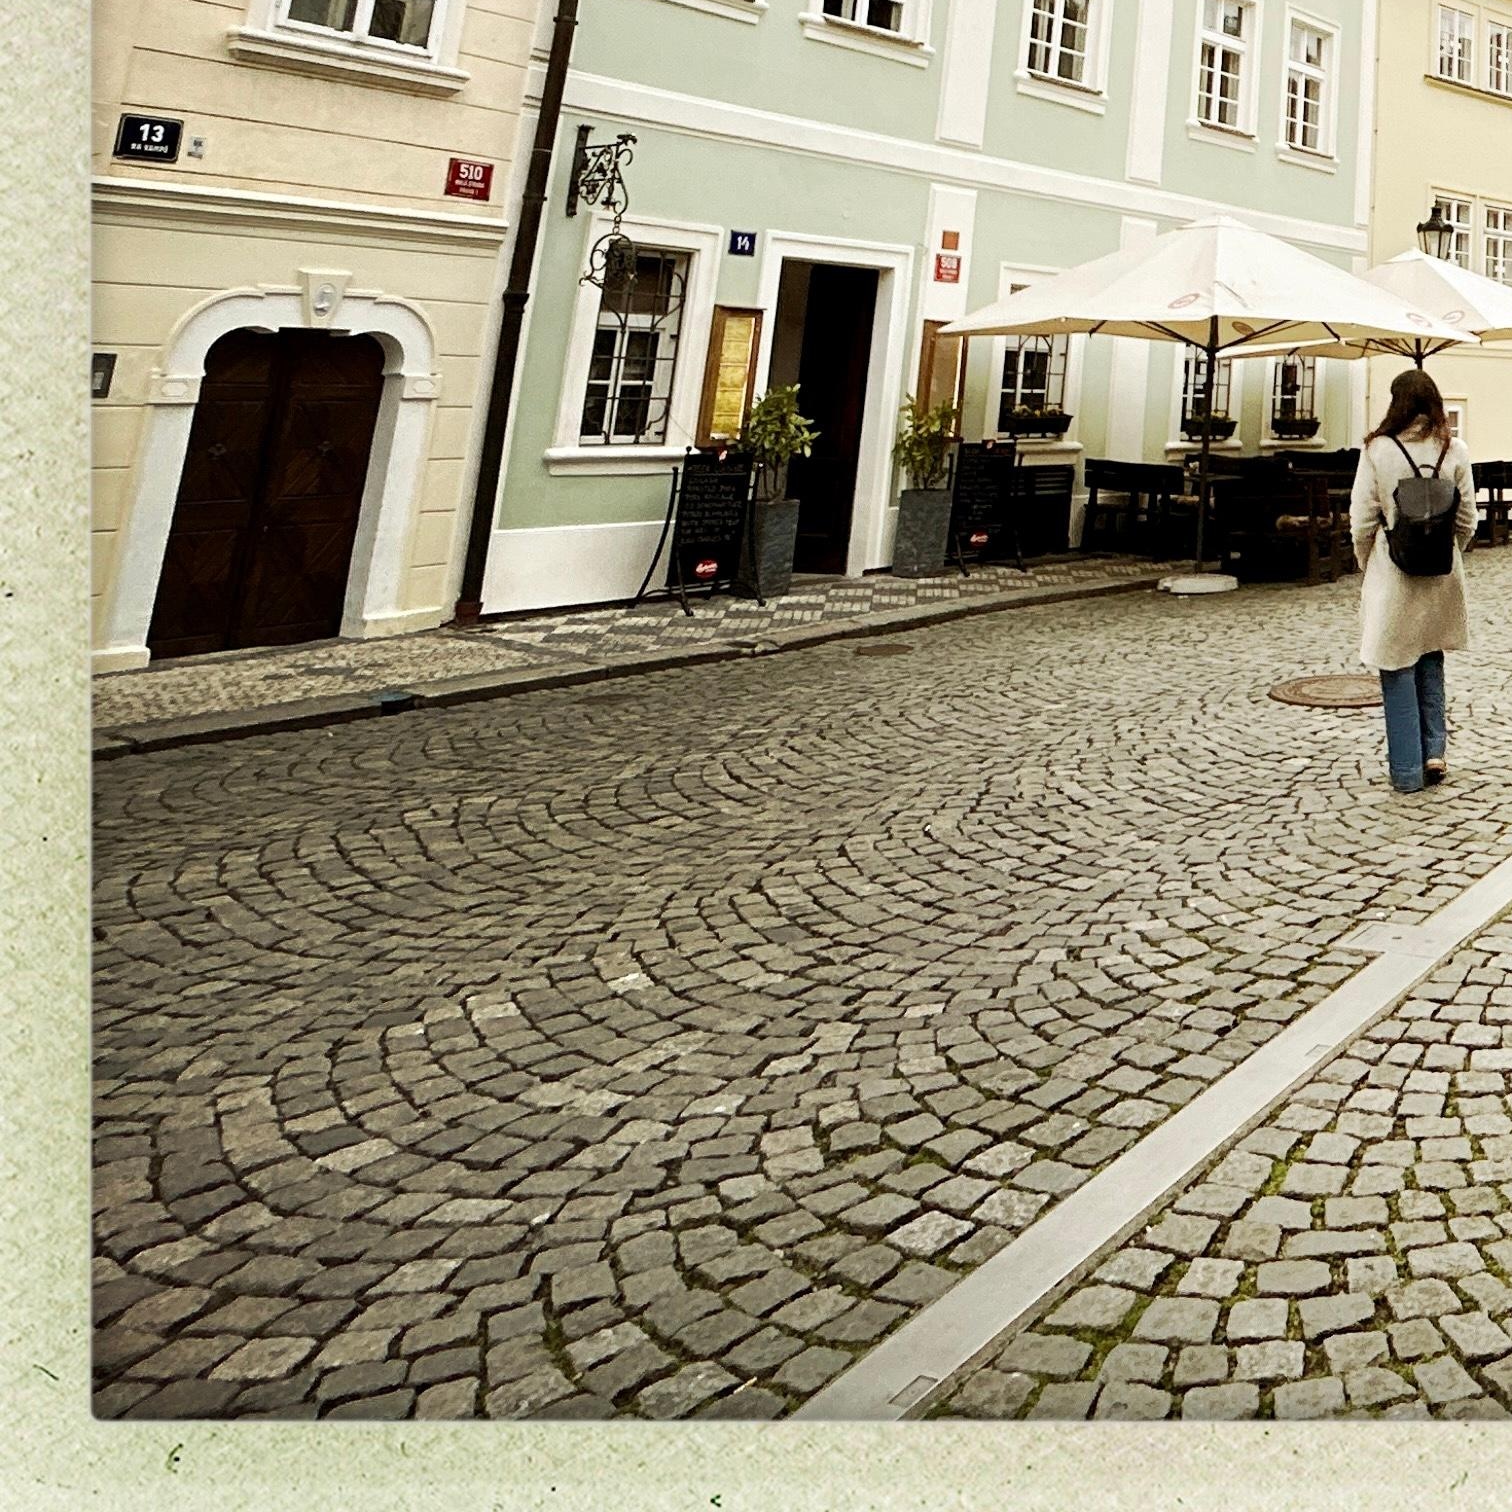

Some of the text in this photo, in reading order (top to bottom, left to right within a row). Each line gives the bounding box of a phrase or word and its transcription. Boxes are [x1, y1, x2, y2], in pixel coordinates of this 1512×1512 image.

[140, 123, 165, 143] 13
[459, 163, 484, 181] 510
[737, 236, 750, 251] 14
